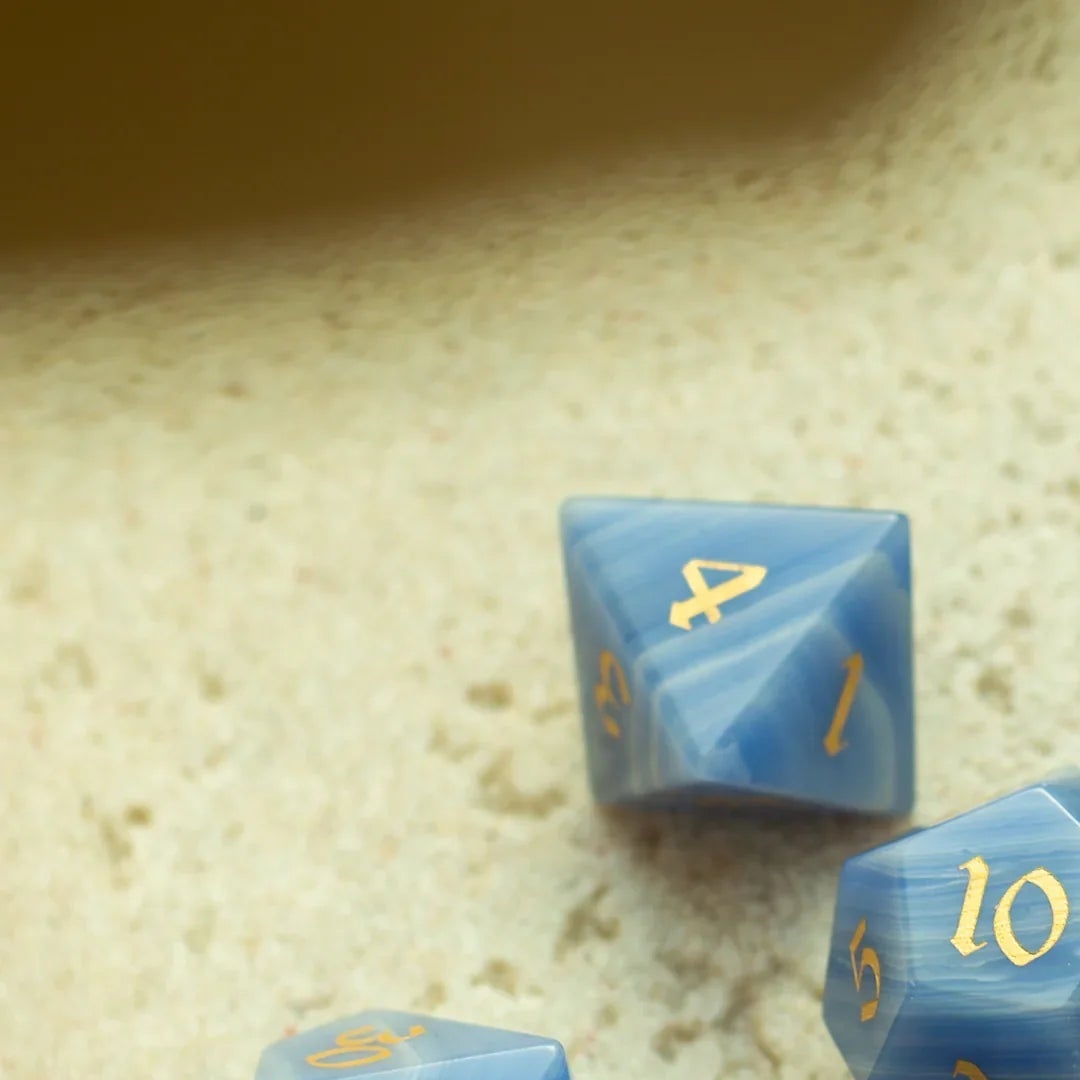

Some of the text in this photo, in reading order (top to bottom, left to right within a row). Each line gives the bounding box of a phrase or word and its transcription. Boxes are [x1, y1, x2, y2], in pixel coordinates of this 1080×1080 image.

[669, 559, 767, 631] 4
[824, 652, 864, 758] 1
[949, 855, 1070, 967] 10
[849, 917, 881, 1023] 5
